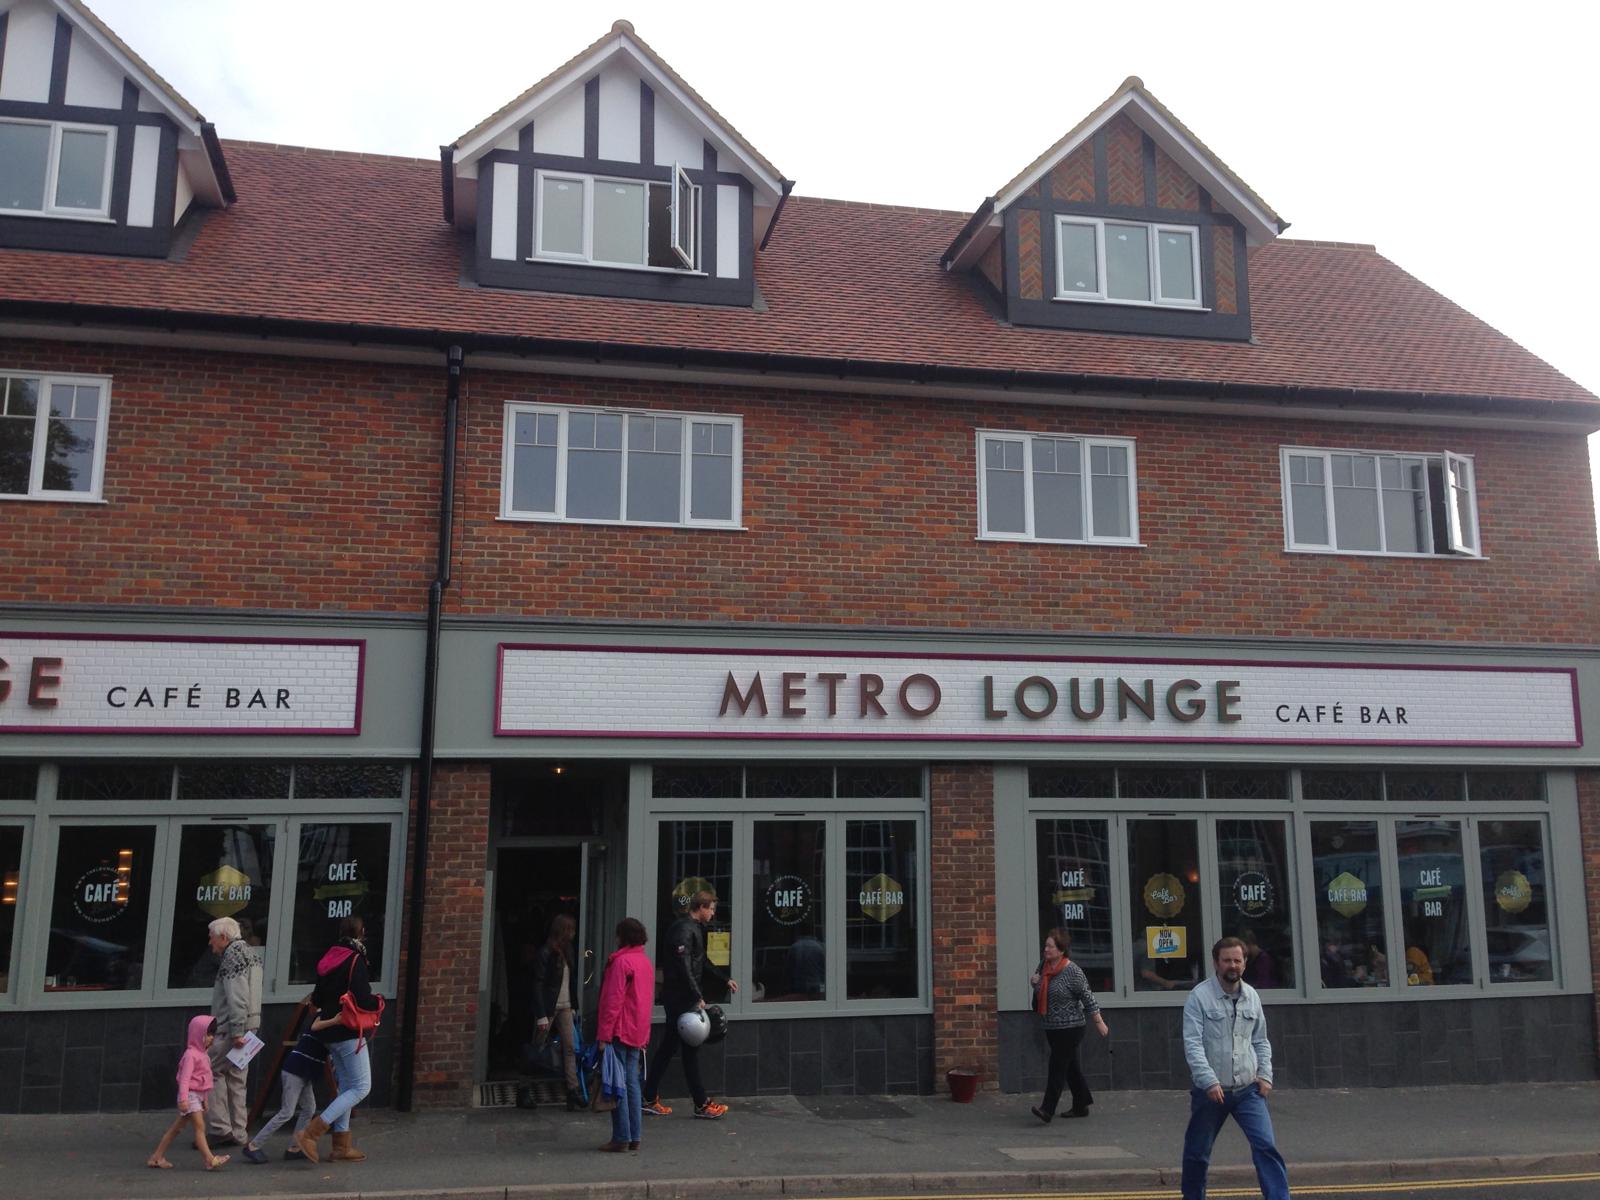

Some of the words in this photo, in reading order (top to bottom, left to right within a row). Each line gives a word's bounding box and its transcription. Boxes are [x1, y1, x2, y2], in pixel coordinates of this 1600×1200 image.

[107, 683, 202, 708] CAFÉ
[225, 688, 291, 709] BAR
[718, 669, 942, 718] METRO
[983, 675, 1243, 724] LOUNGE
[1276, 701, 1343, 723] CAFÉ
[1360, 706, 1408, 724] BAR
[328, 859, 358, 881] CAFÉ
[1061, 868, 1085, 887] CAFÉ
[1420, 867, 1442, 886] CAFÉ
[84, 878, 120, 902] CAFÉ
[229, 885, 252, 900] BAR
[774, 886, 803, 907] CAFÉ
[859, 888, 882, 905] CAFÉ
[885, 891, 904, 905] BAR
[1240, 881, 1266, 901] CAFÉ
[1351, 888, 1367, 902] BAR
[327, 899, 352, 918] BAR
[1064, 903, 1084, 920] BAR
[1424, 901, 1442, 916] BAR
[1158, 938, 1174, 947] OPEN
[1159, 929, 1172, 938] NOW
